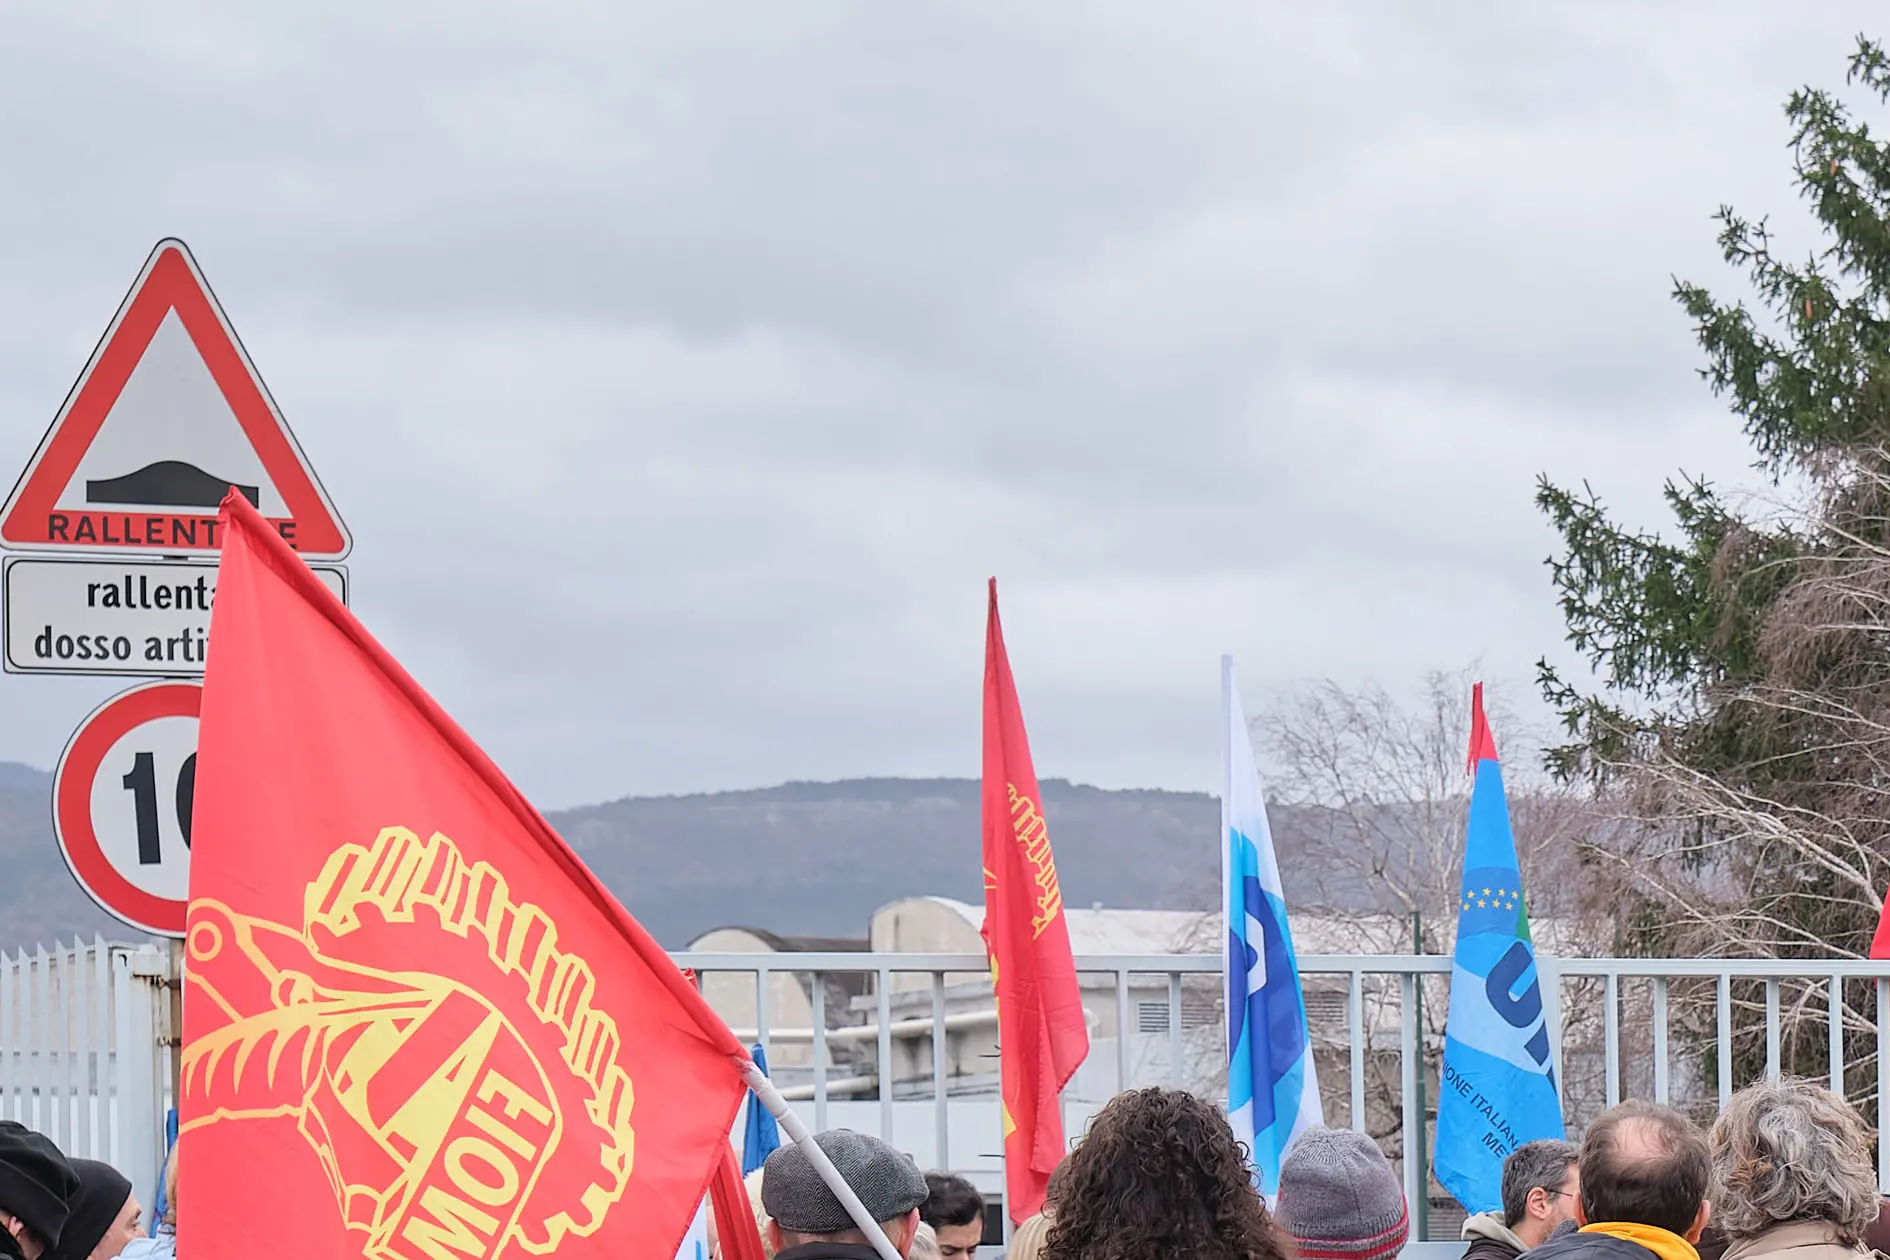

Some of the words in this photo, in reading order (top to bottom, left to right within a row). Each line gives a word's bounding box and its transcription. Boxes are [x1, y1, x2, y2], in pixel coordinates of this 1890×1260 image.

[48, 513, 298, 549] RALLENTE
[35, 625, 131, 661] dosso
[145, 628, 209, 662] arti
[1469, 1092, 1520, 1152] ITALIAN
[1481, 1131, 1510, 1159] ME
